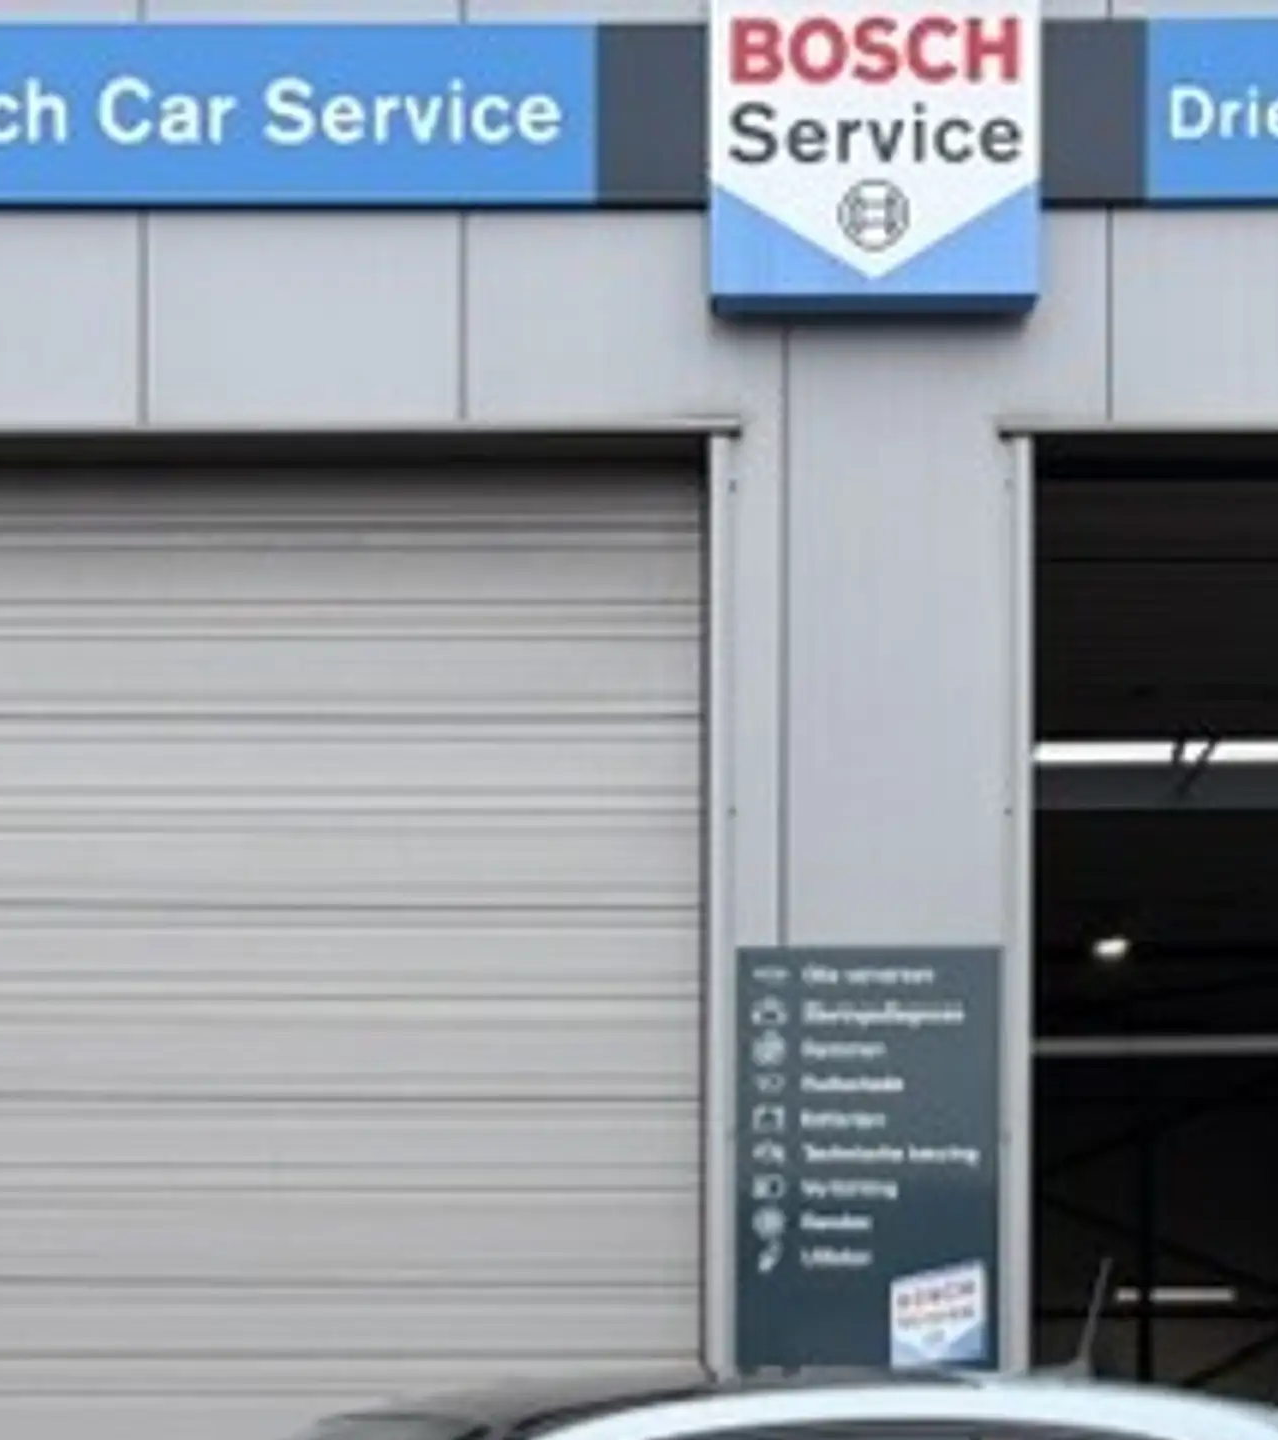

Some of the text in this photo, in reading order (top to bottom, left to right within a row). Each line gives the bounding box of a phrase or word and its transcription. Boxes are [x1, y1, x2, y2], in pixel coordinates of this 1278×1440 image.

[729, 16, 1020, 85] BOSCH
[99, 77, 235, 143] Car
[264, 77, 562, 144] Service
[728, 101, 1022, 164] Service
